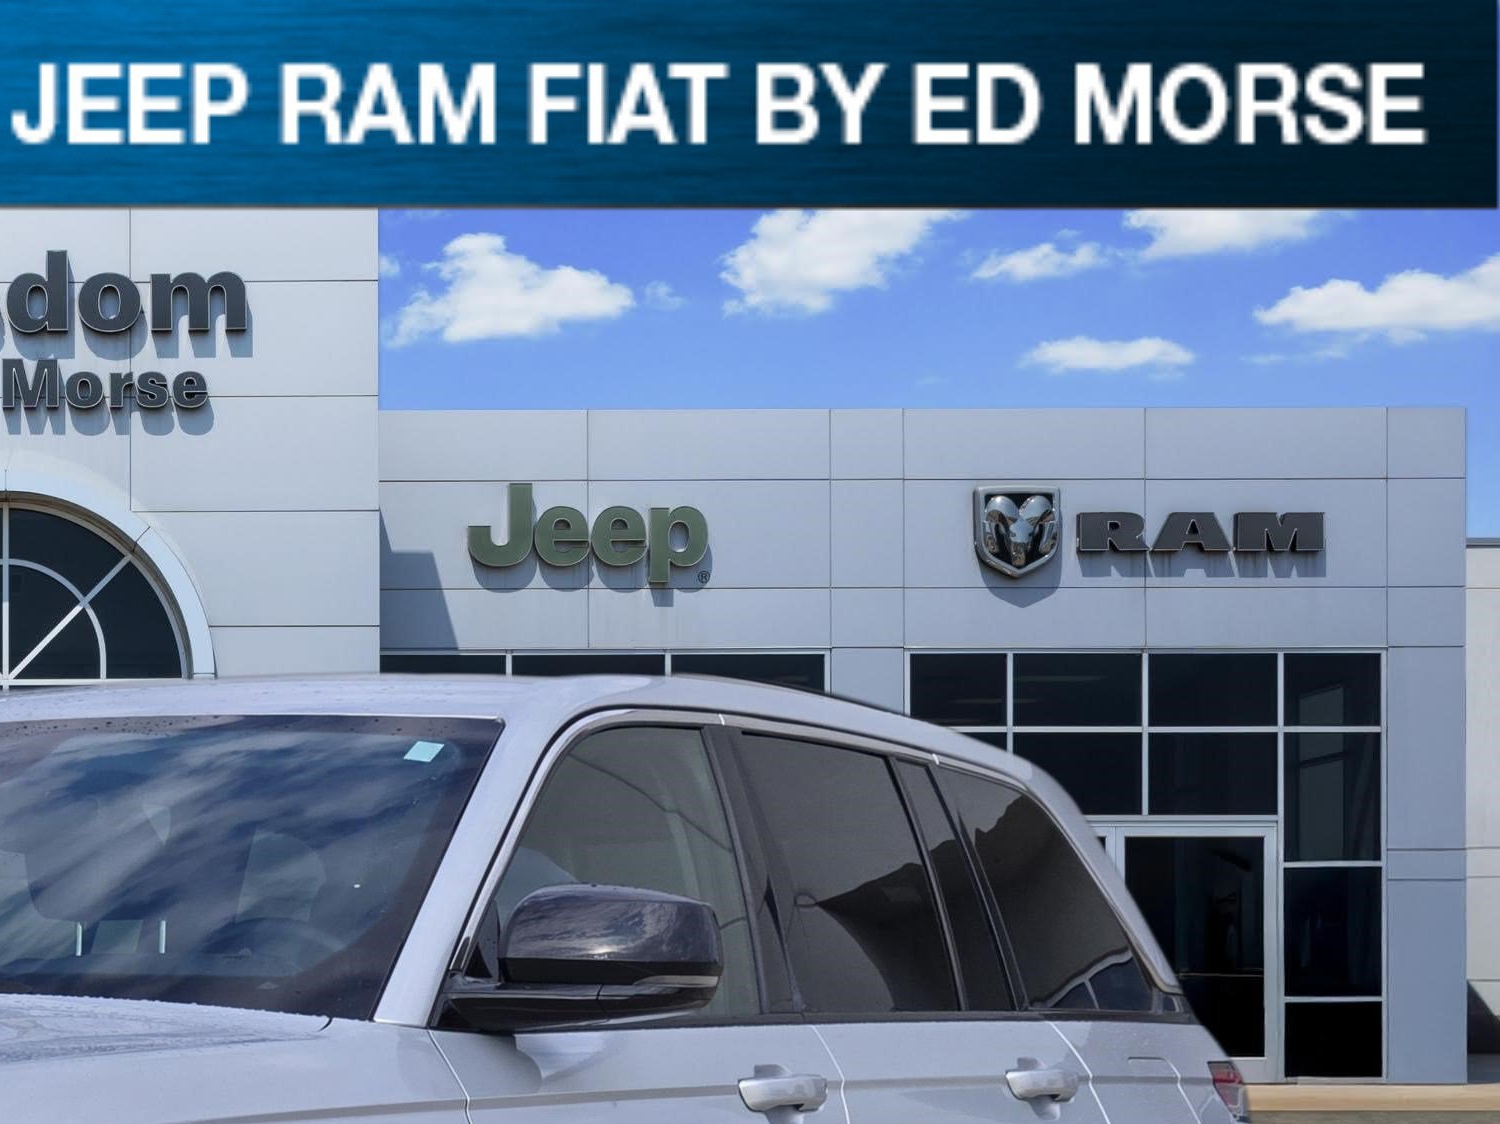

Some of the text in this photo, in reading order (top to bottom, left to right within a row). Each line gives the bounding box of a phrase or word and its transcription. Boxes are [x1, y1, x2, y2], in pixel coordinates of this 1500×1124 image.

[1, 357, 209, 410] Morse
[466, 482, 710, 584] Jeep
[1075, 511, 1326, 552] RAM
